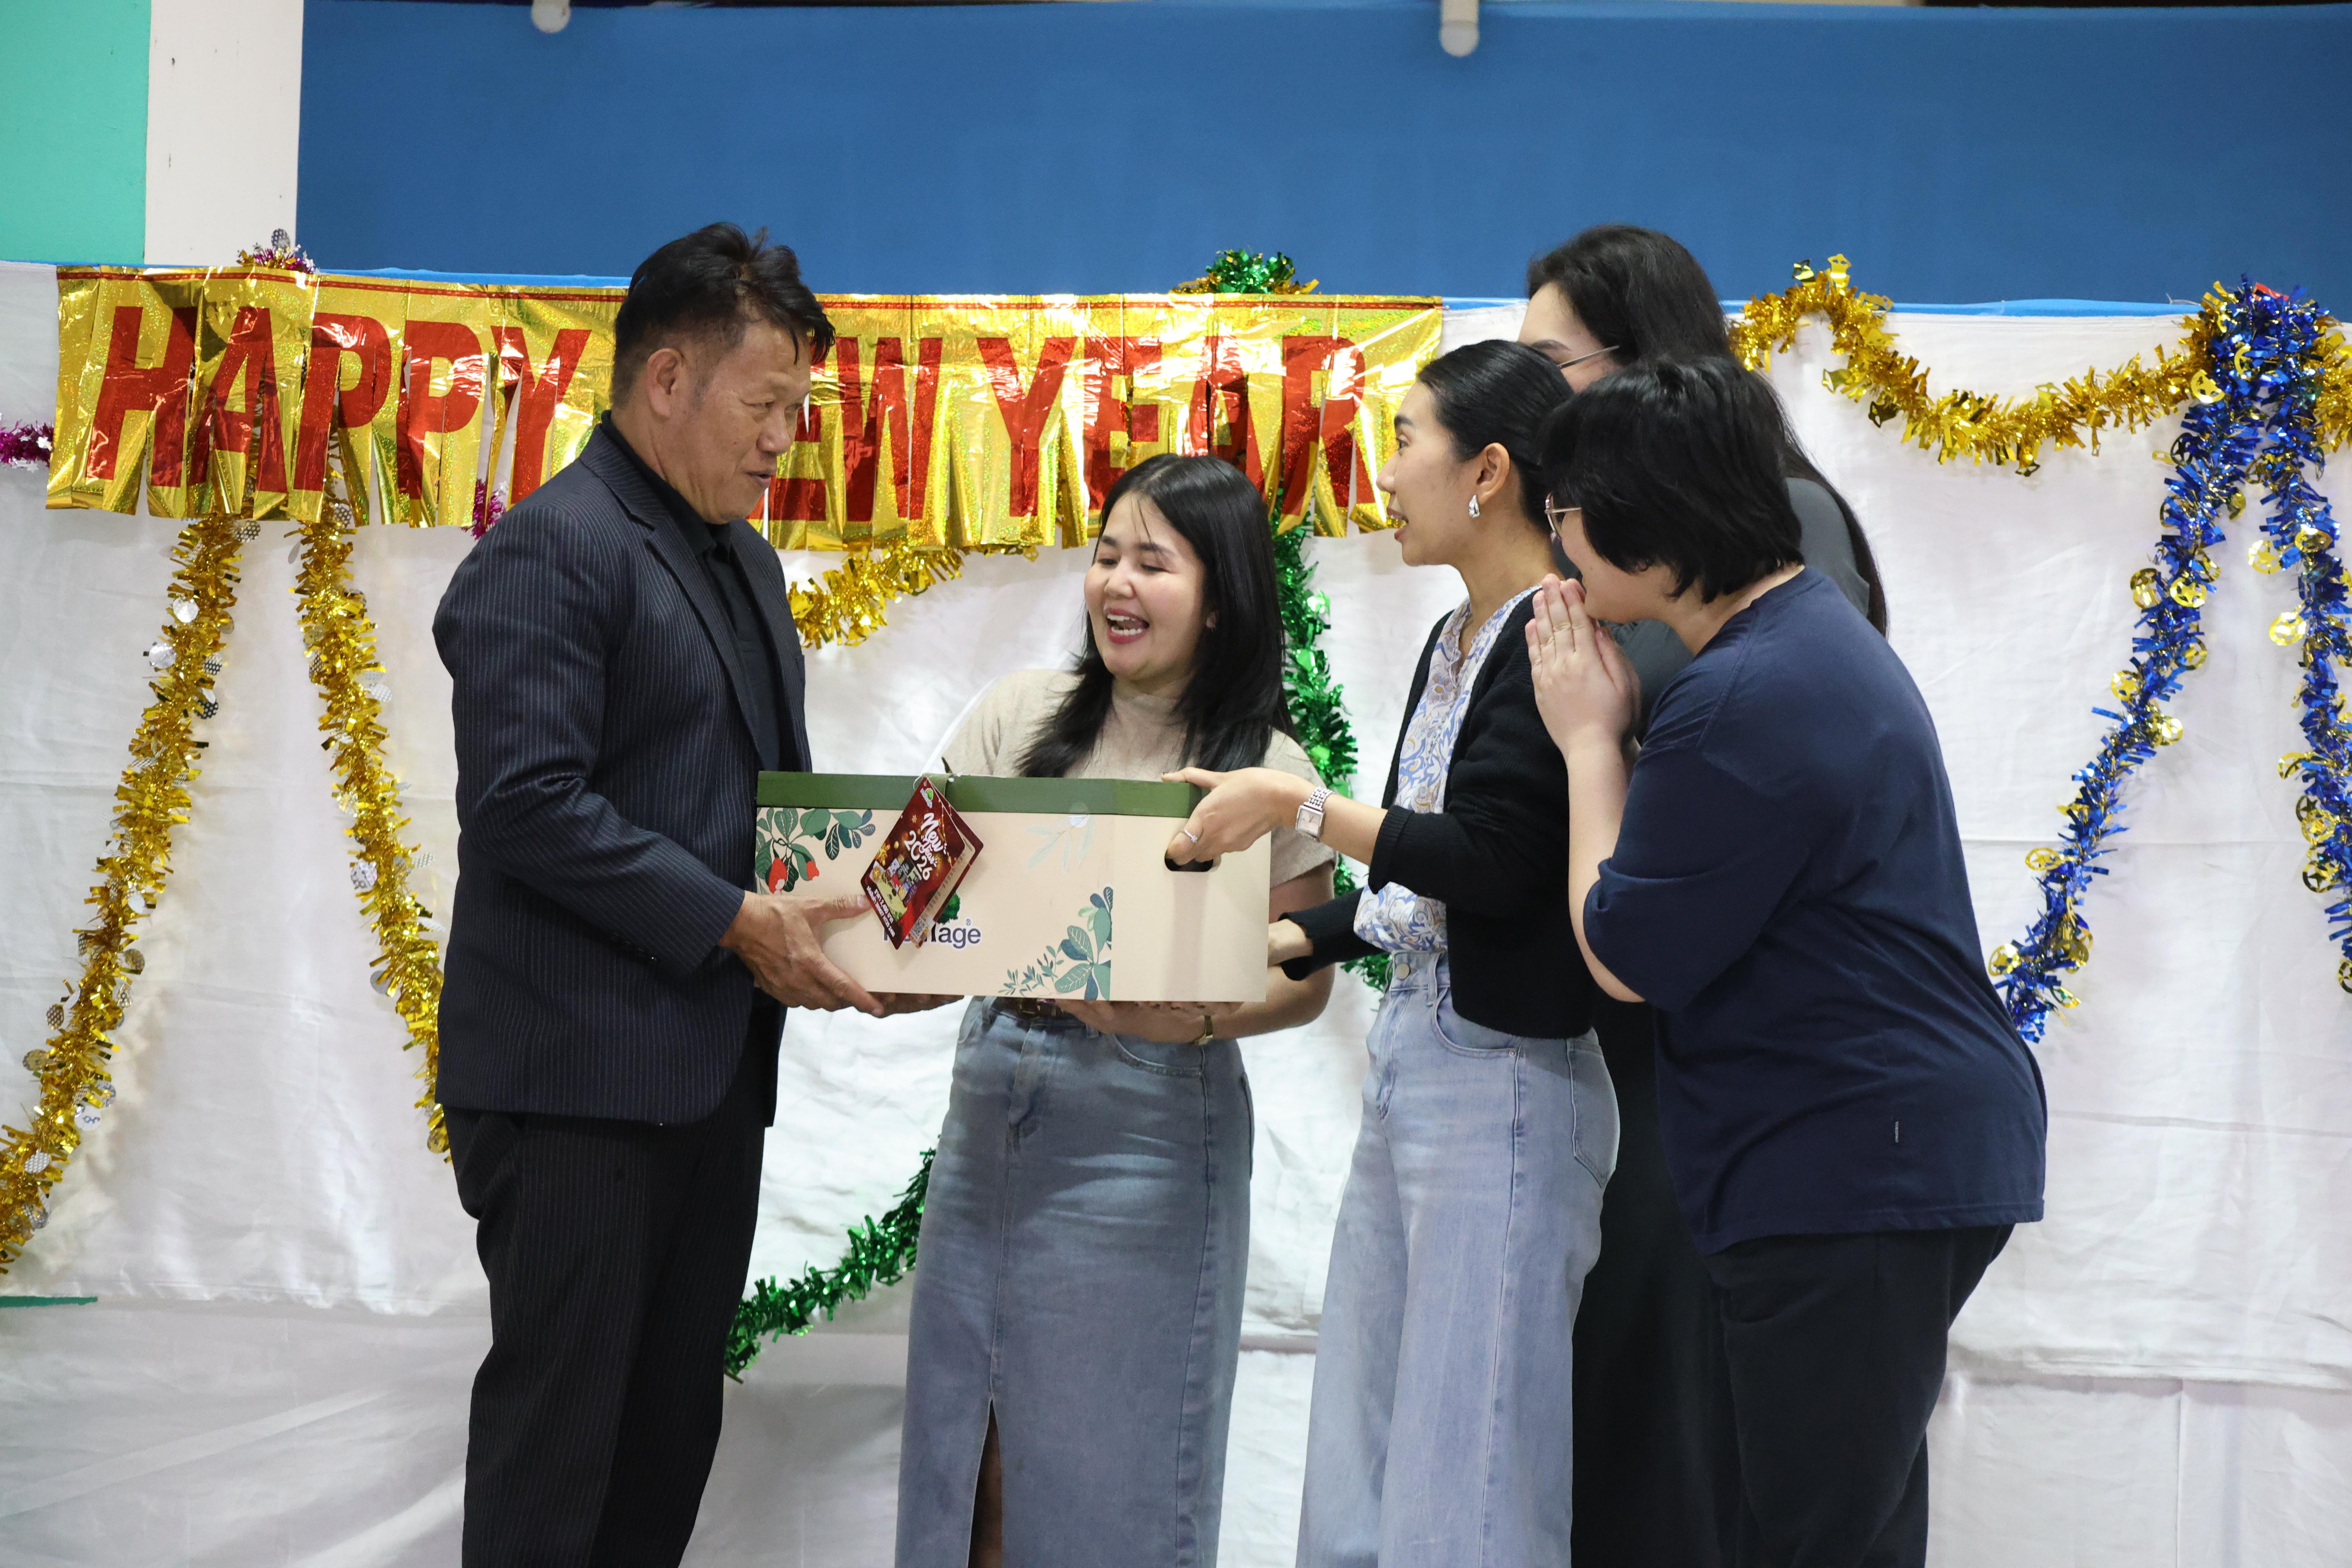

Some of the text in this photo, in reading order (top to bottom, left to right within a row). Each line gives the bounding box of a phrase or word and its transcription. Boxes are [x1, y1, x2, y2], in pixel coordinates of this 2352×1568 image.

[85, 306, 592, 505] HAPPY
[980, 335, 1377, 517] YEAR
[918, 838, 935, 865] Year
[920, 812, 944, 852] New
[904, 830, 933, 880] 2026
